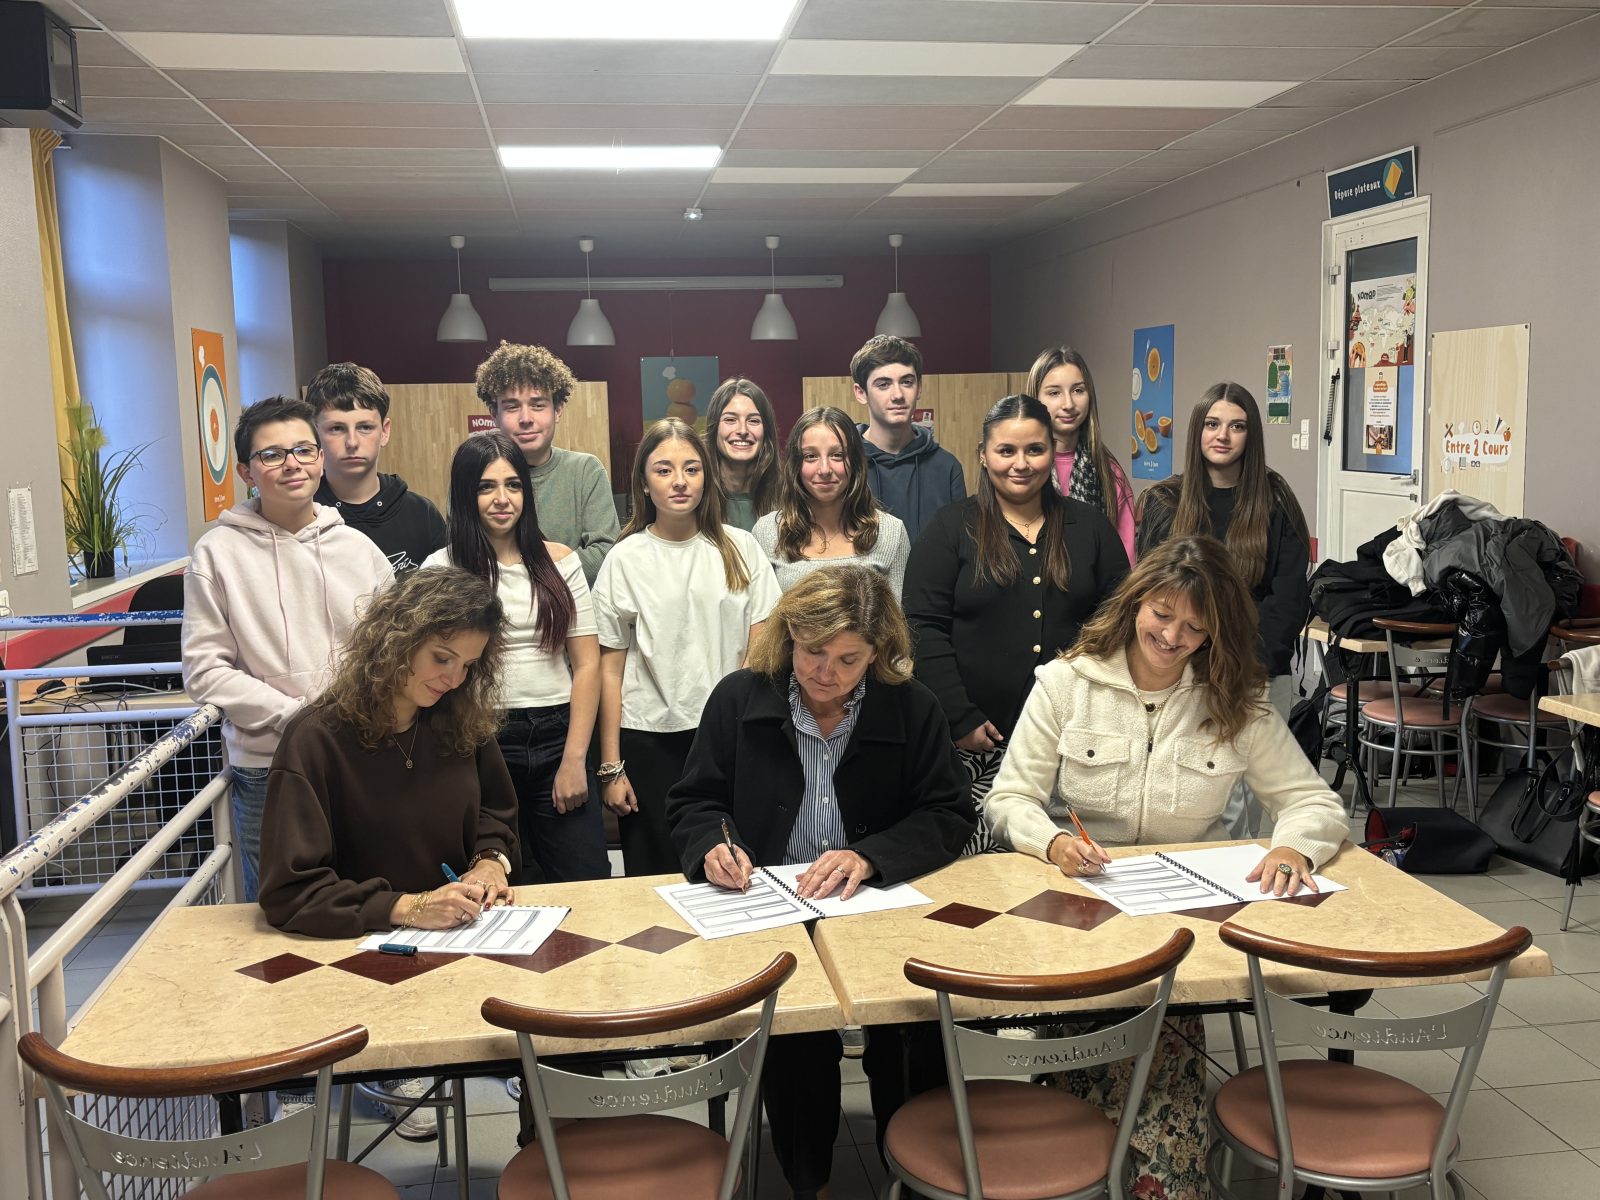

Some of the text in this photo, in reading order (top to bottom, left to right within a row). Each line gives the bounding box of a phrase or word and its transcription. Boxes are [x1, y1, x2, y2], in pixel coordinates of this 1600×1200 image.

[1354, 180, 1381, 198] plateaux
[1445, 438, 1509, 457] Entre 2 Cours
